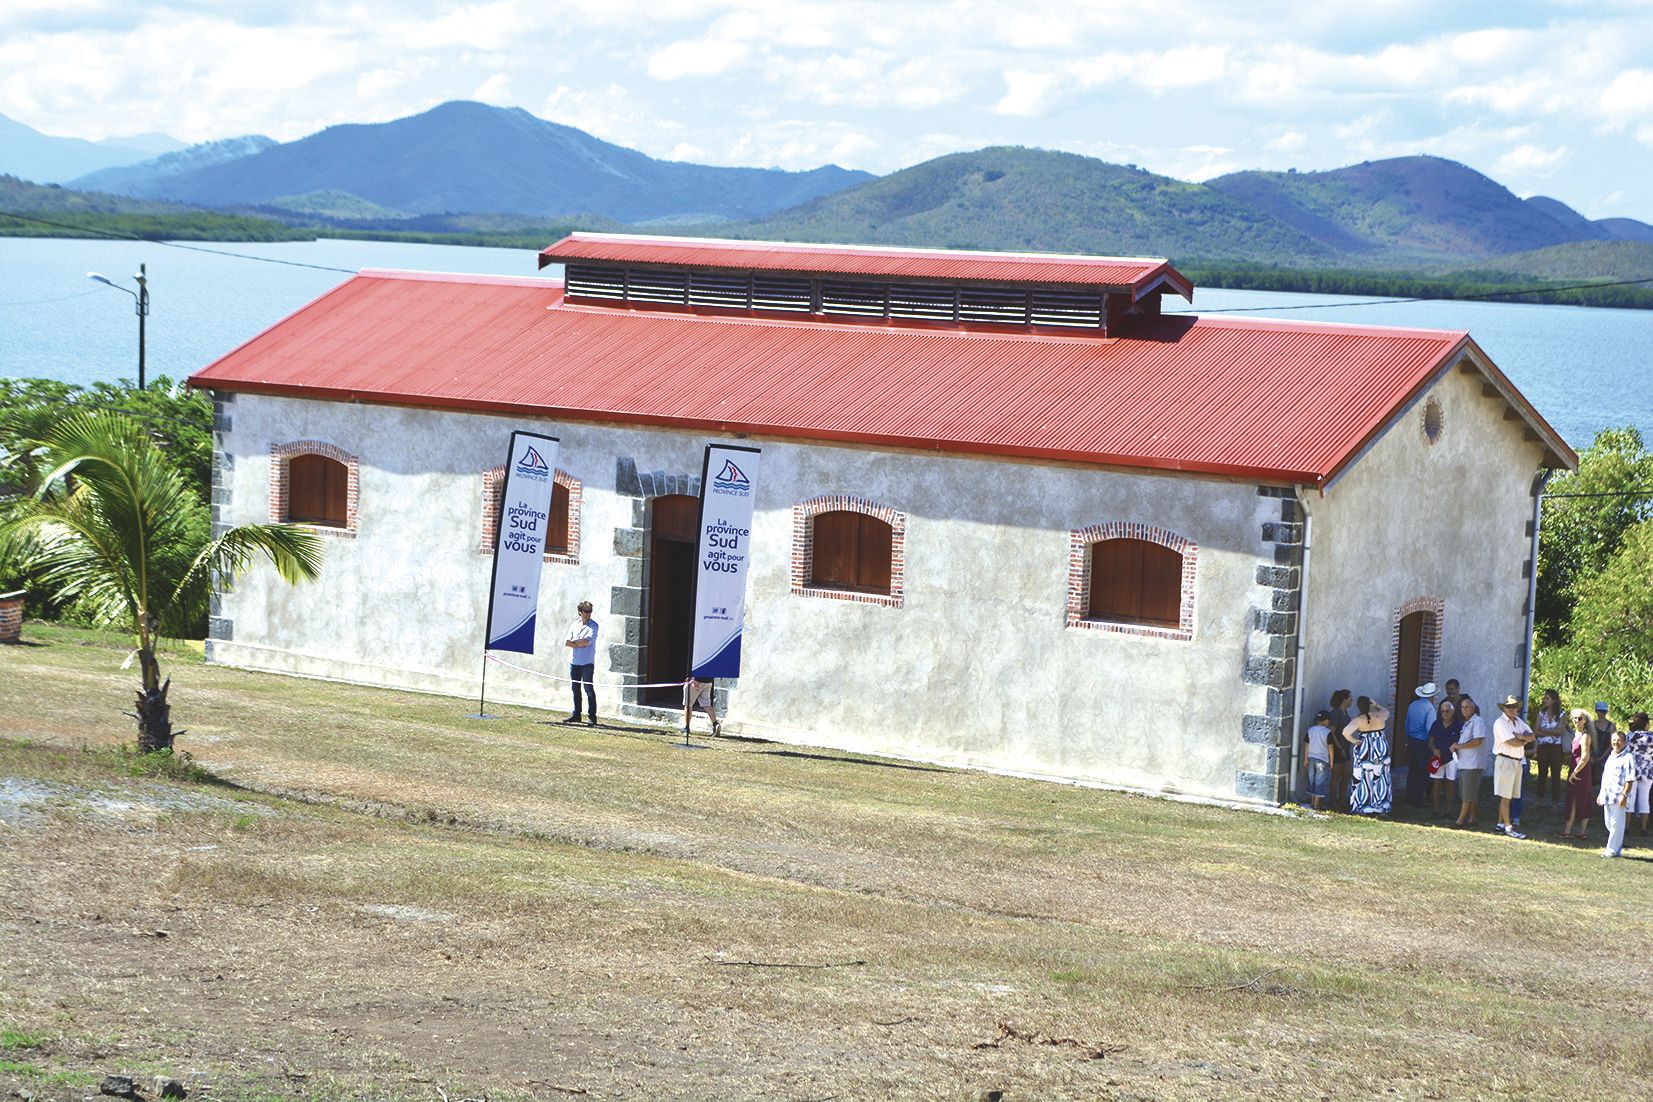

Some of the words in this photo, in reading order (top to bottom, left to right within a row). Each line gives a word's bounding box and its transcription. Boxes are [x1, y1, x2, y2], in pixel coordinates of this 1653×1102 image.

[713, 488, 737, 496] PROVINCE
[519, 501, 527, 509] La
[508, 507, 546, 520] province
[510, 515, 537, 531] Sud
[718, 518, 727, 526] La
[508, 531, 526, 542] agit
[706, 524, 749, 537] province
[709, 533, 738, 549] Sud
[708, 550, 726, 561] agit
[727, 554, 744, 562] pour
